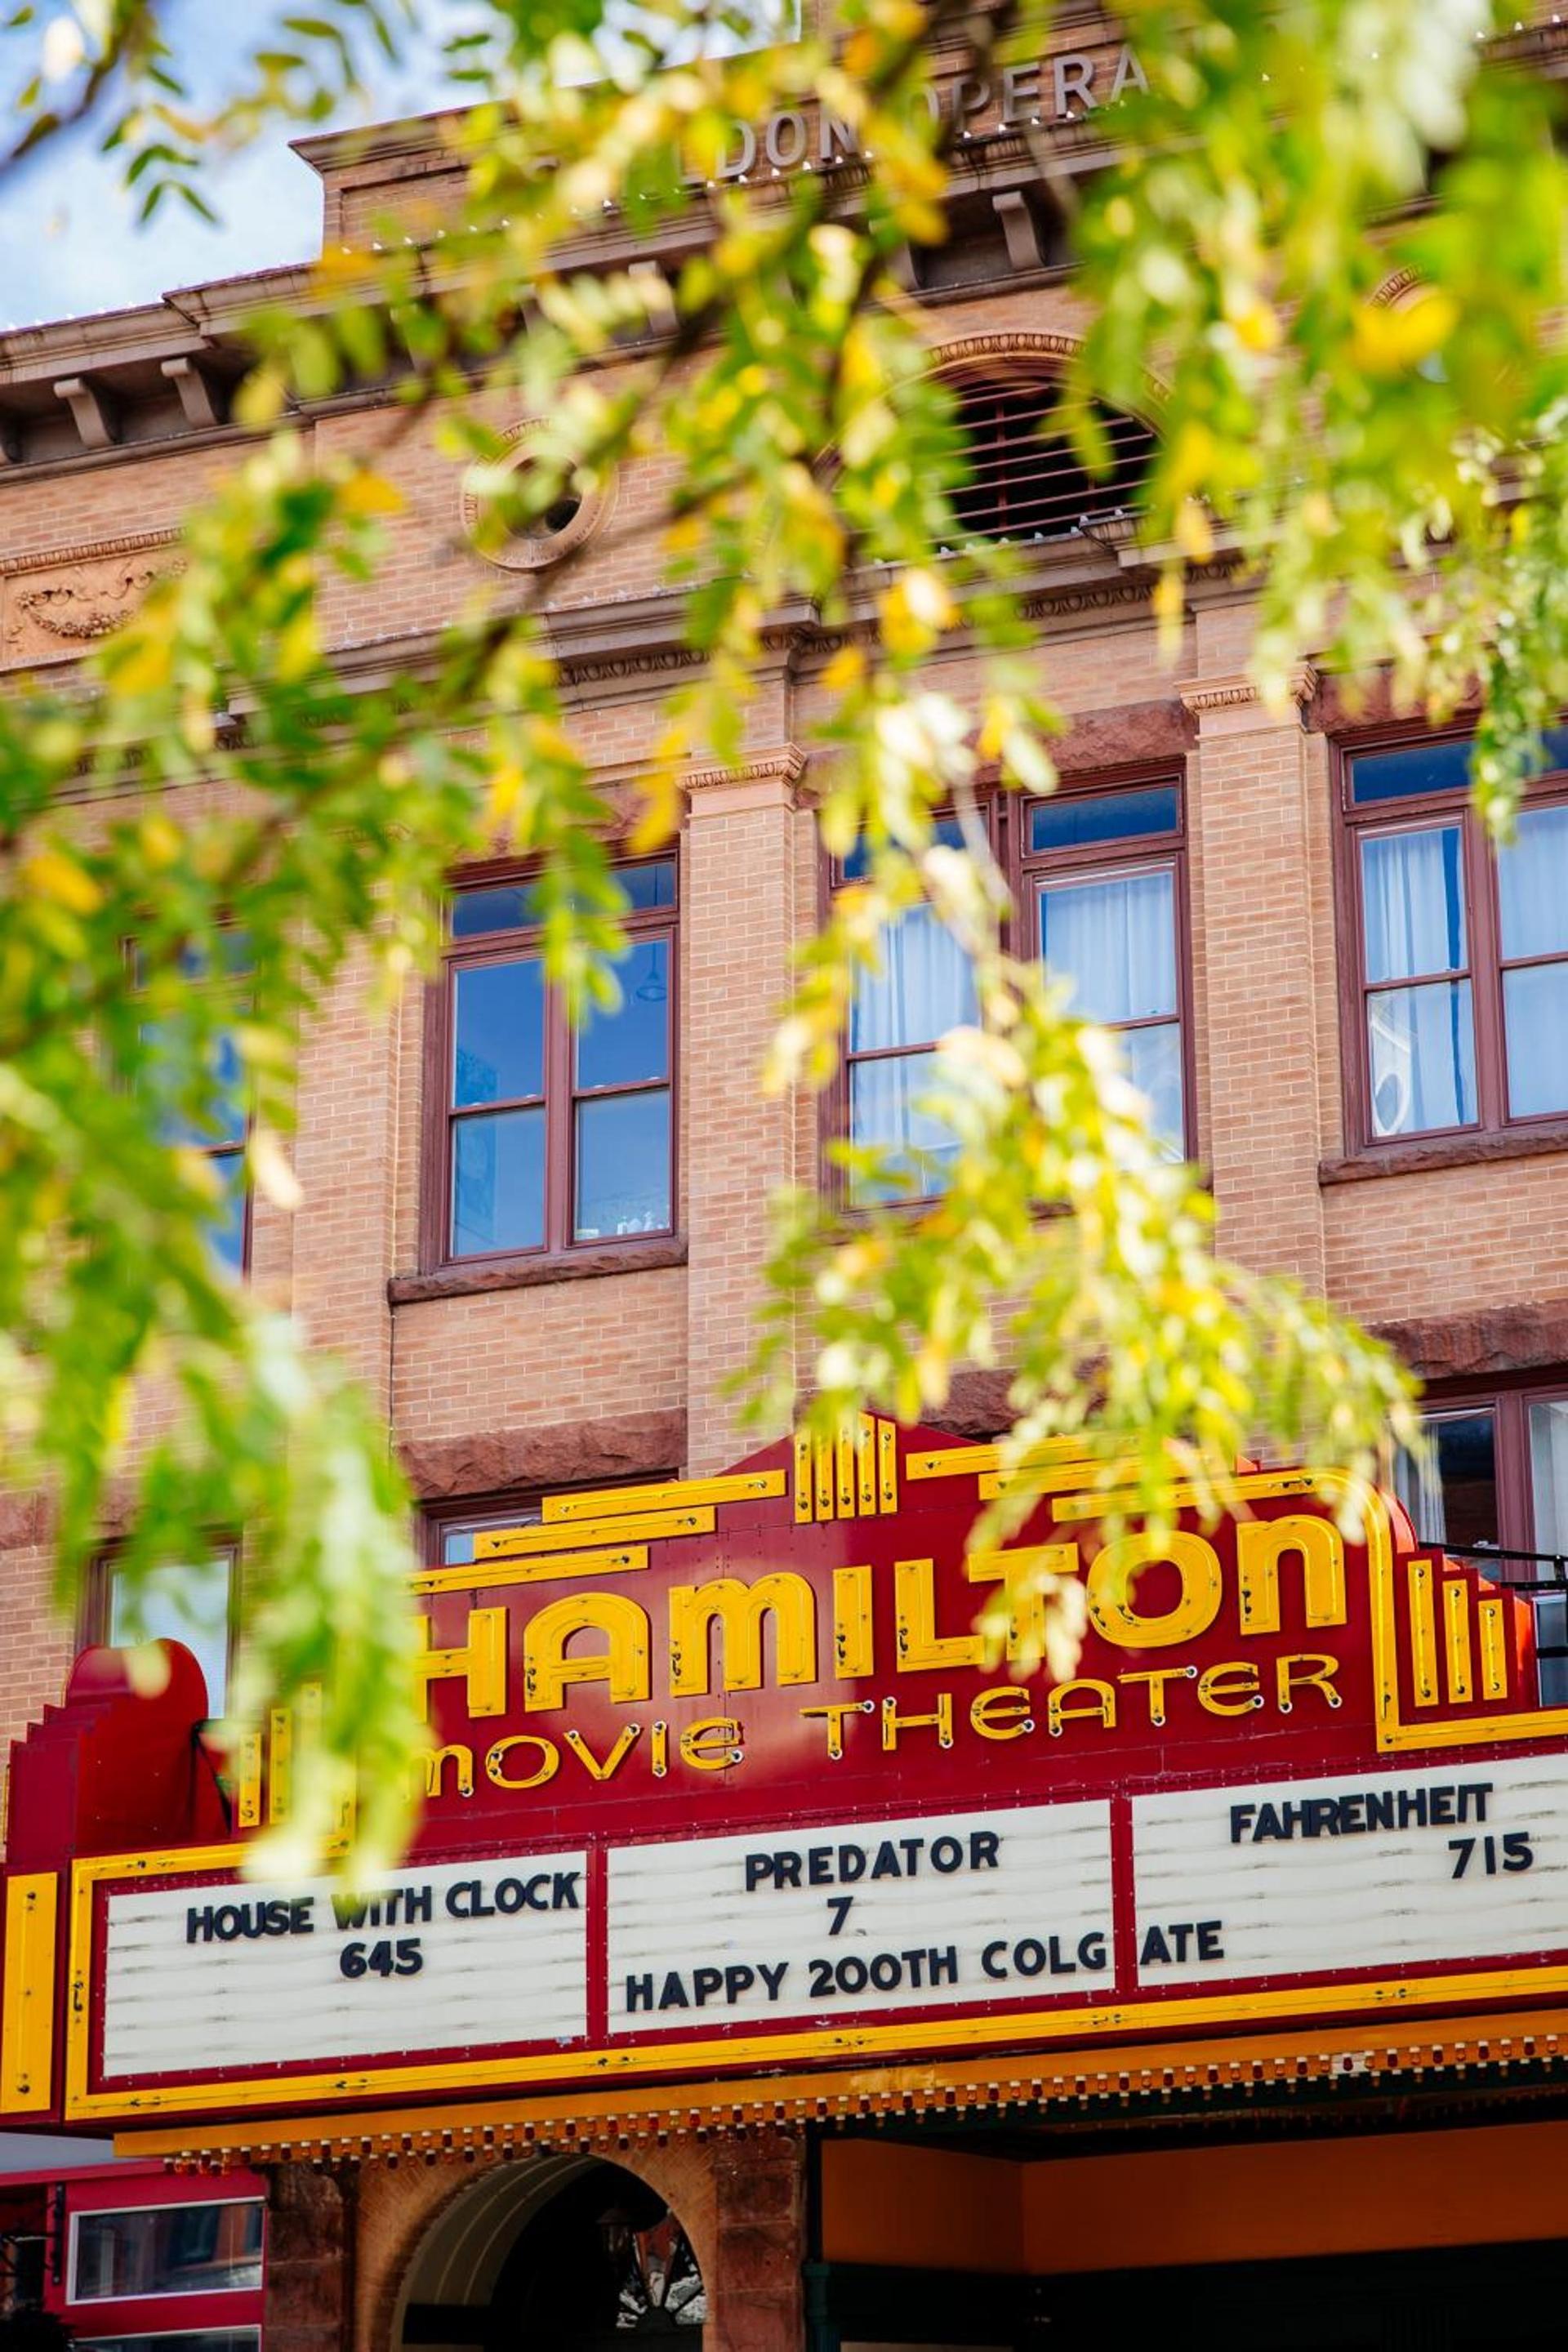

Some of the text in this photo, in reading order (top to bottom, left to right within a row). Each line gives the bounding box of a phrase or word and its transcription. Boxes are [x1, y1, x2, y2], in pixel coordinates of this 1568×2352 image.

[901, 42, 1148, 136] OPERA
[407, 1515, 1347, 1724] HAMILTON
[416, 1654, 1342, 1797] MOVIE THEATER
[1230, 1783, 1494, 1843] FAHRENHEIT
[745, 1831, 1000, 1891] PREDATOR
[1449, 1832, 1534, 1878] 715
[187, 1872, 581, 1943] HOUSE WITH CLOCK
[826, 1895, 854, 1936] 7
[340, 1937, 423, 1980] 645
[626, 1932, 1107, 2012] HAPPY 200TH COLG
[1140, 1920, 1224, 1966] ATE
